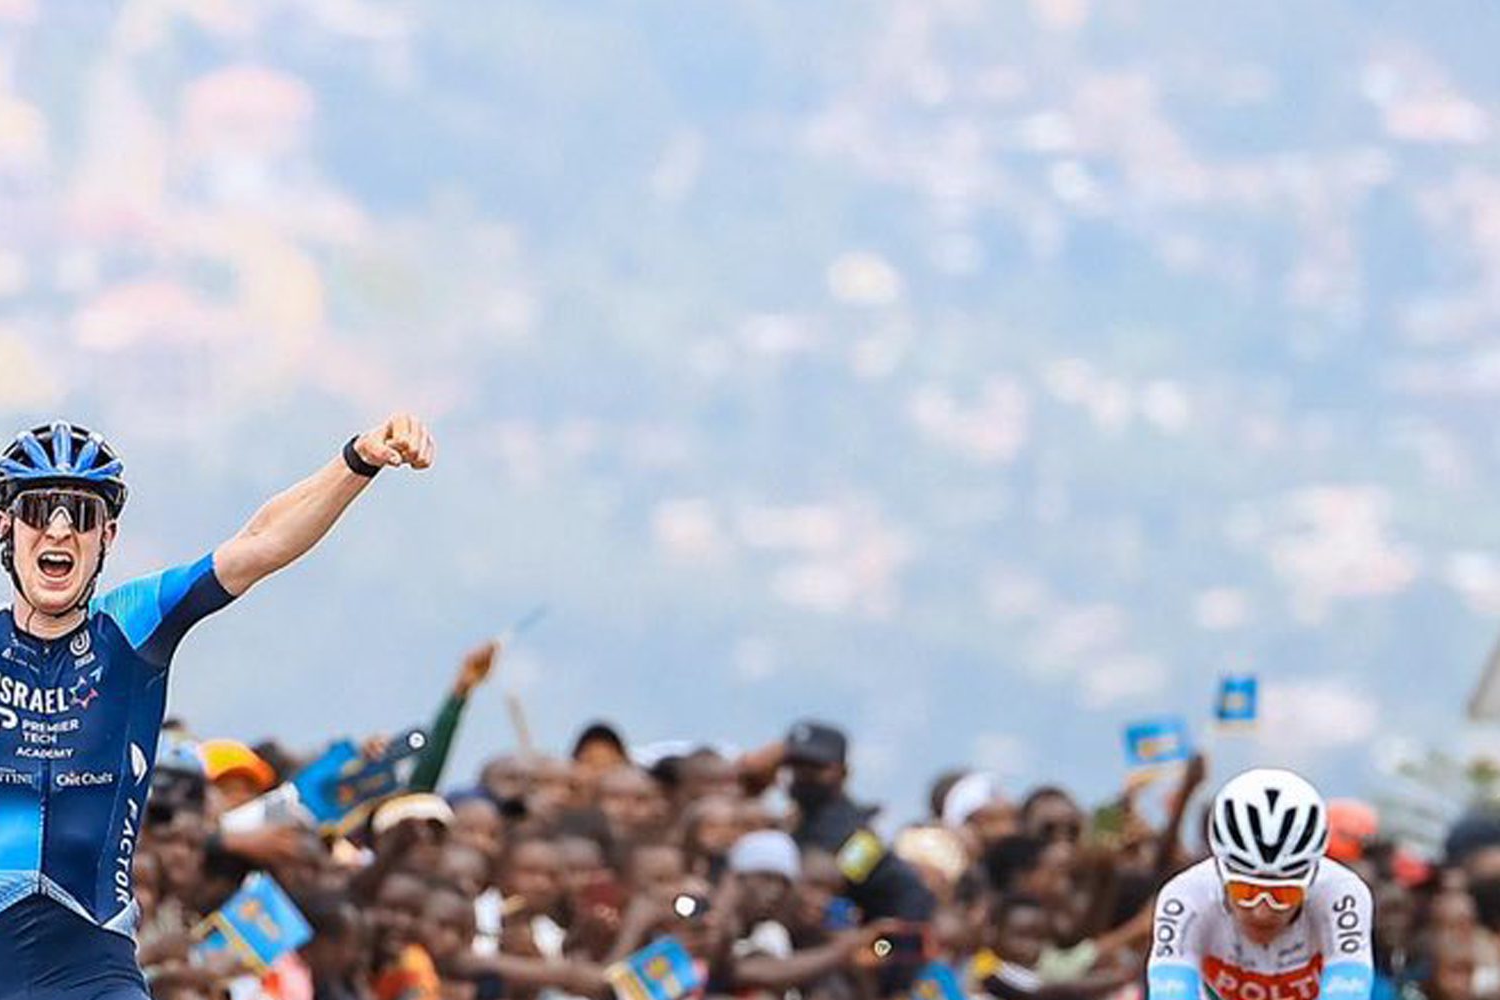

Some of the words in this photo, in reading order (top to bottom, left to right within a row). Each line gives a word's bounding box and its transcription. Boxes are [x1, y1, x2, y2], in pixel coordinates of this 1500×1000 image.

[21, 718, 80, 733] PREMIER
[23, 731, 57, 744] TECH
[15, 746, 75, 760] ACADEMY
[114, 798, 139, 906] FACTOR
